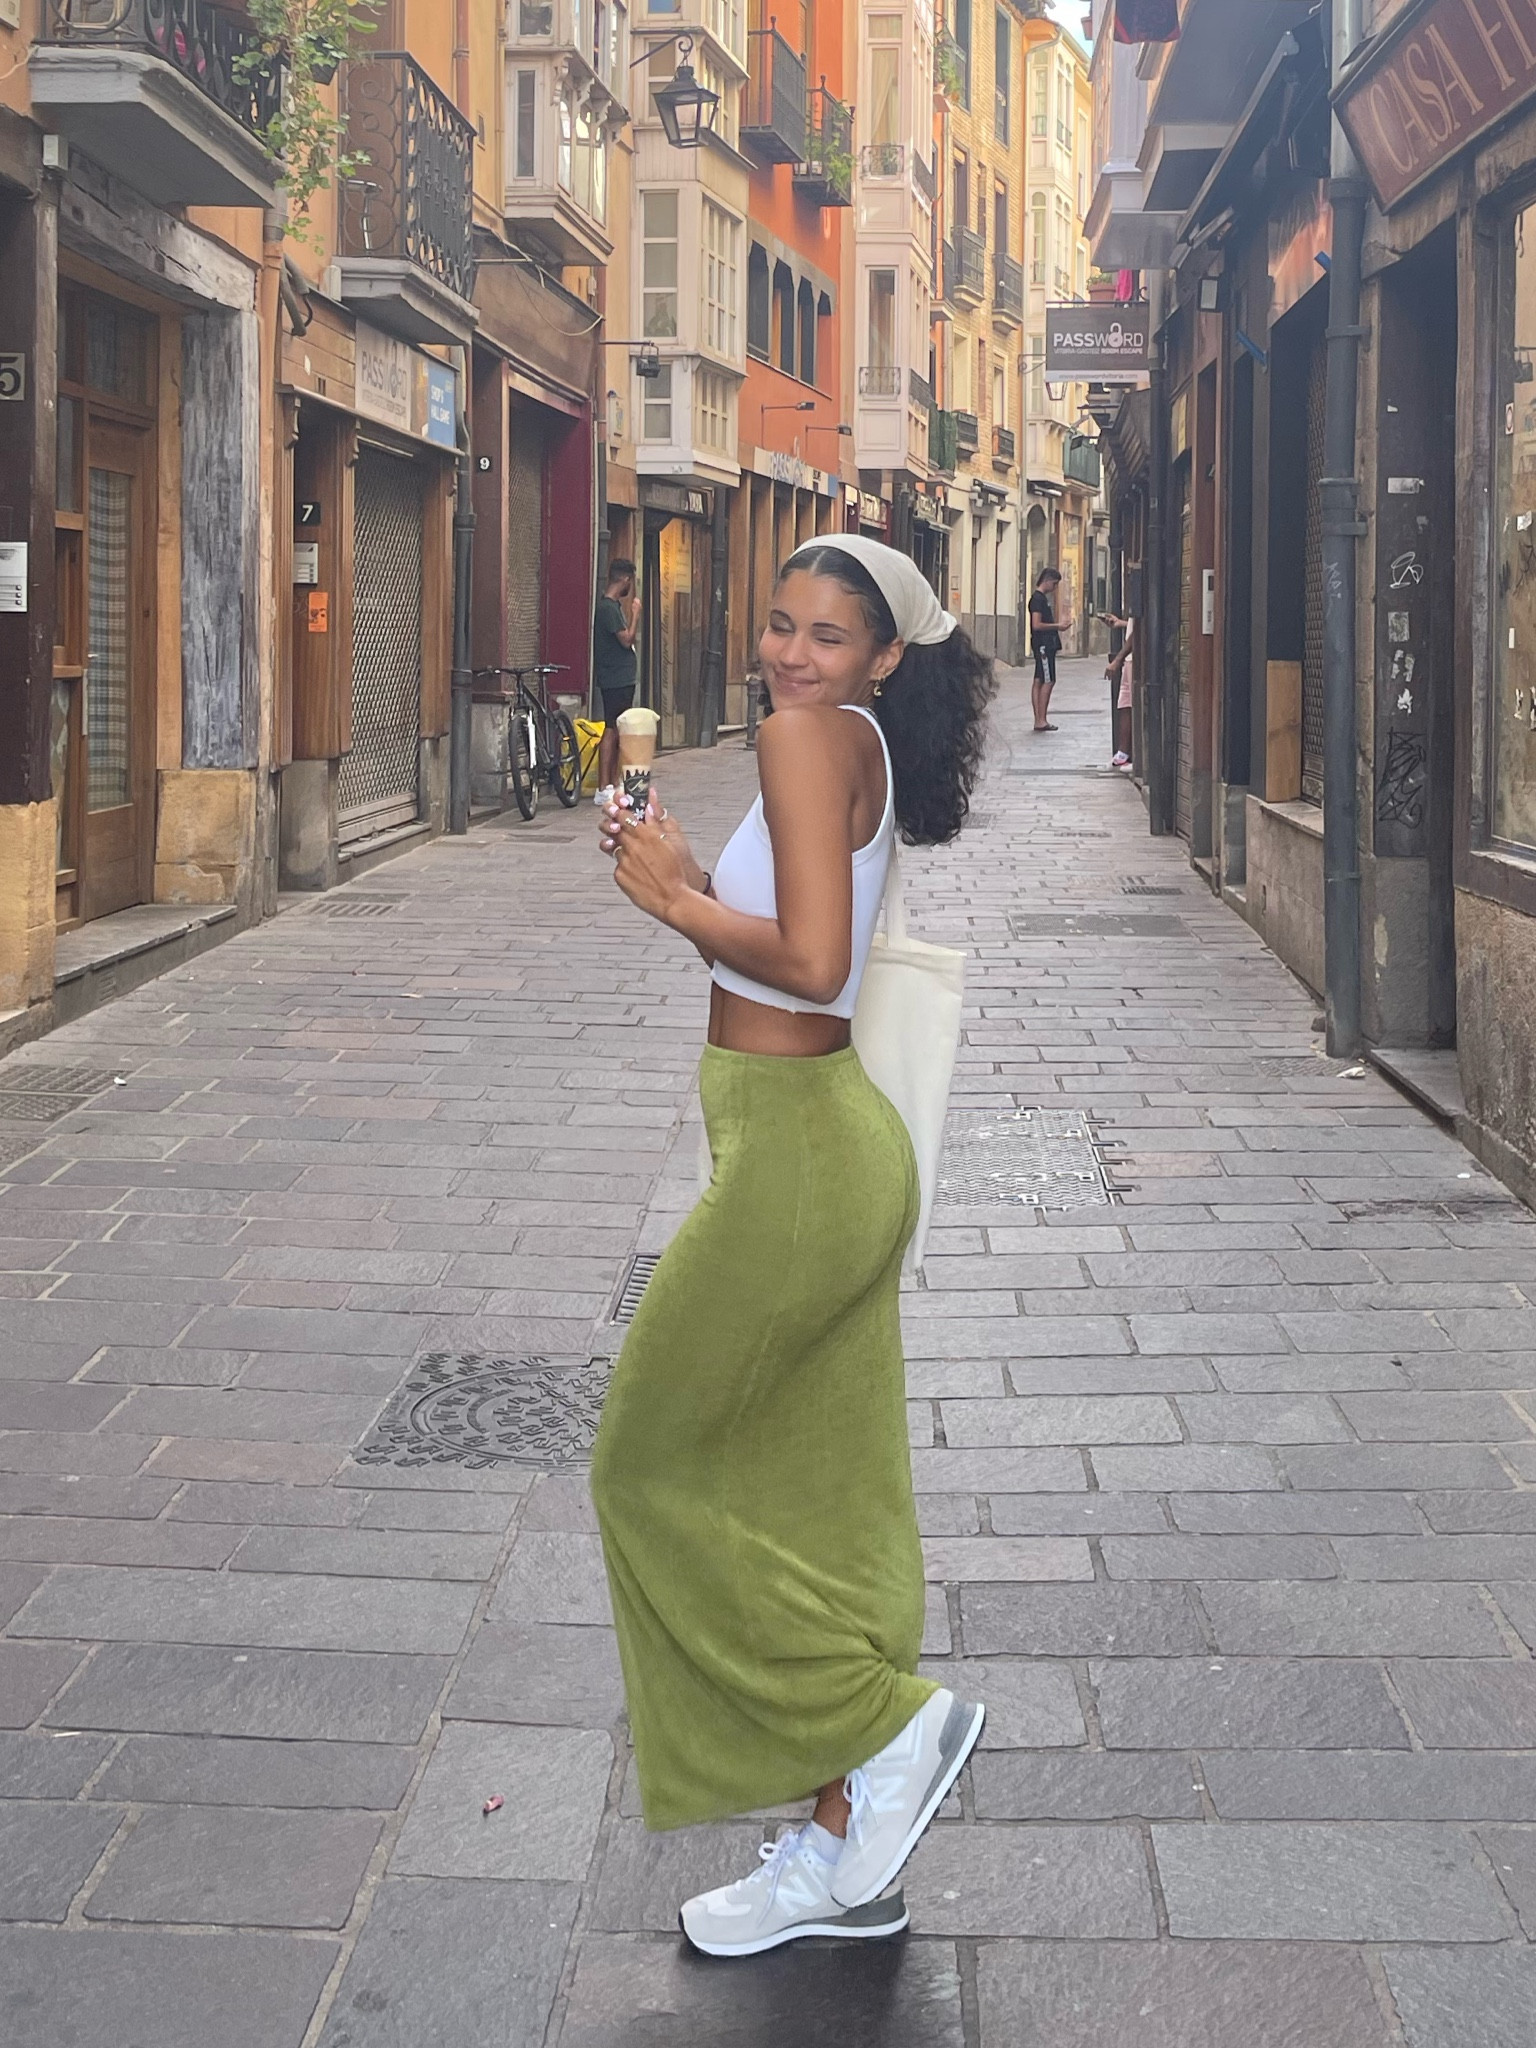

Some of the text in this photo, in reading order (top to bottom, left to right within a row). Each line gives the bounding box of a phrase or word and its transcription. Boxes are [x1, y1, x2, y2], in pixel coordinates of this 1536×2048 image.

[1367, 23, 1484, 174] CASA
[1053, 326, 1144, 348] PASSWORD
[479, 457, 490, 470] 9
[302, 504, 314, 522] 7
